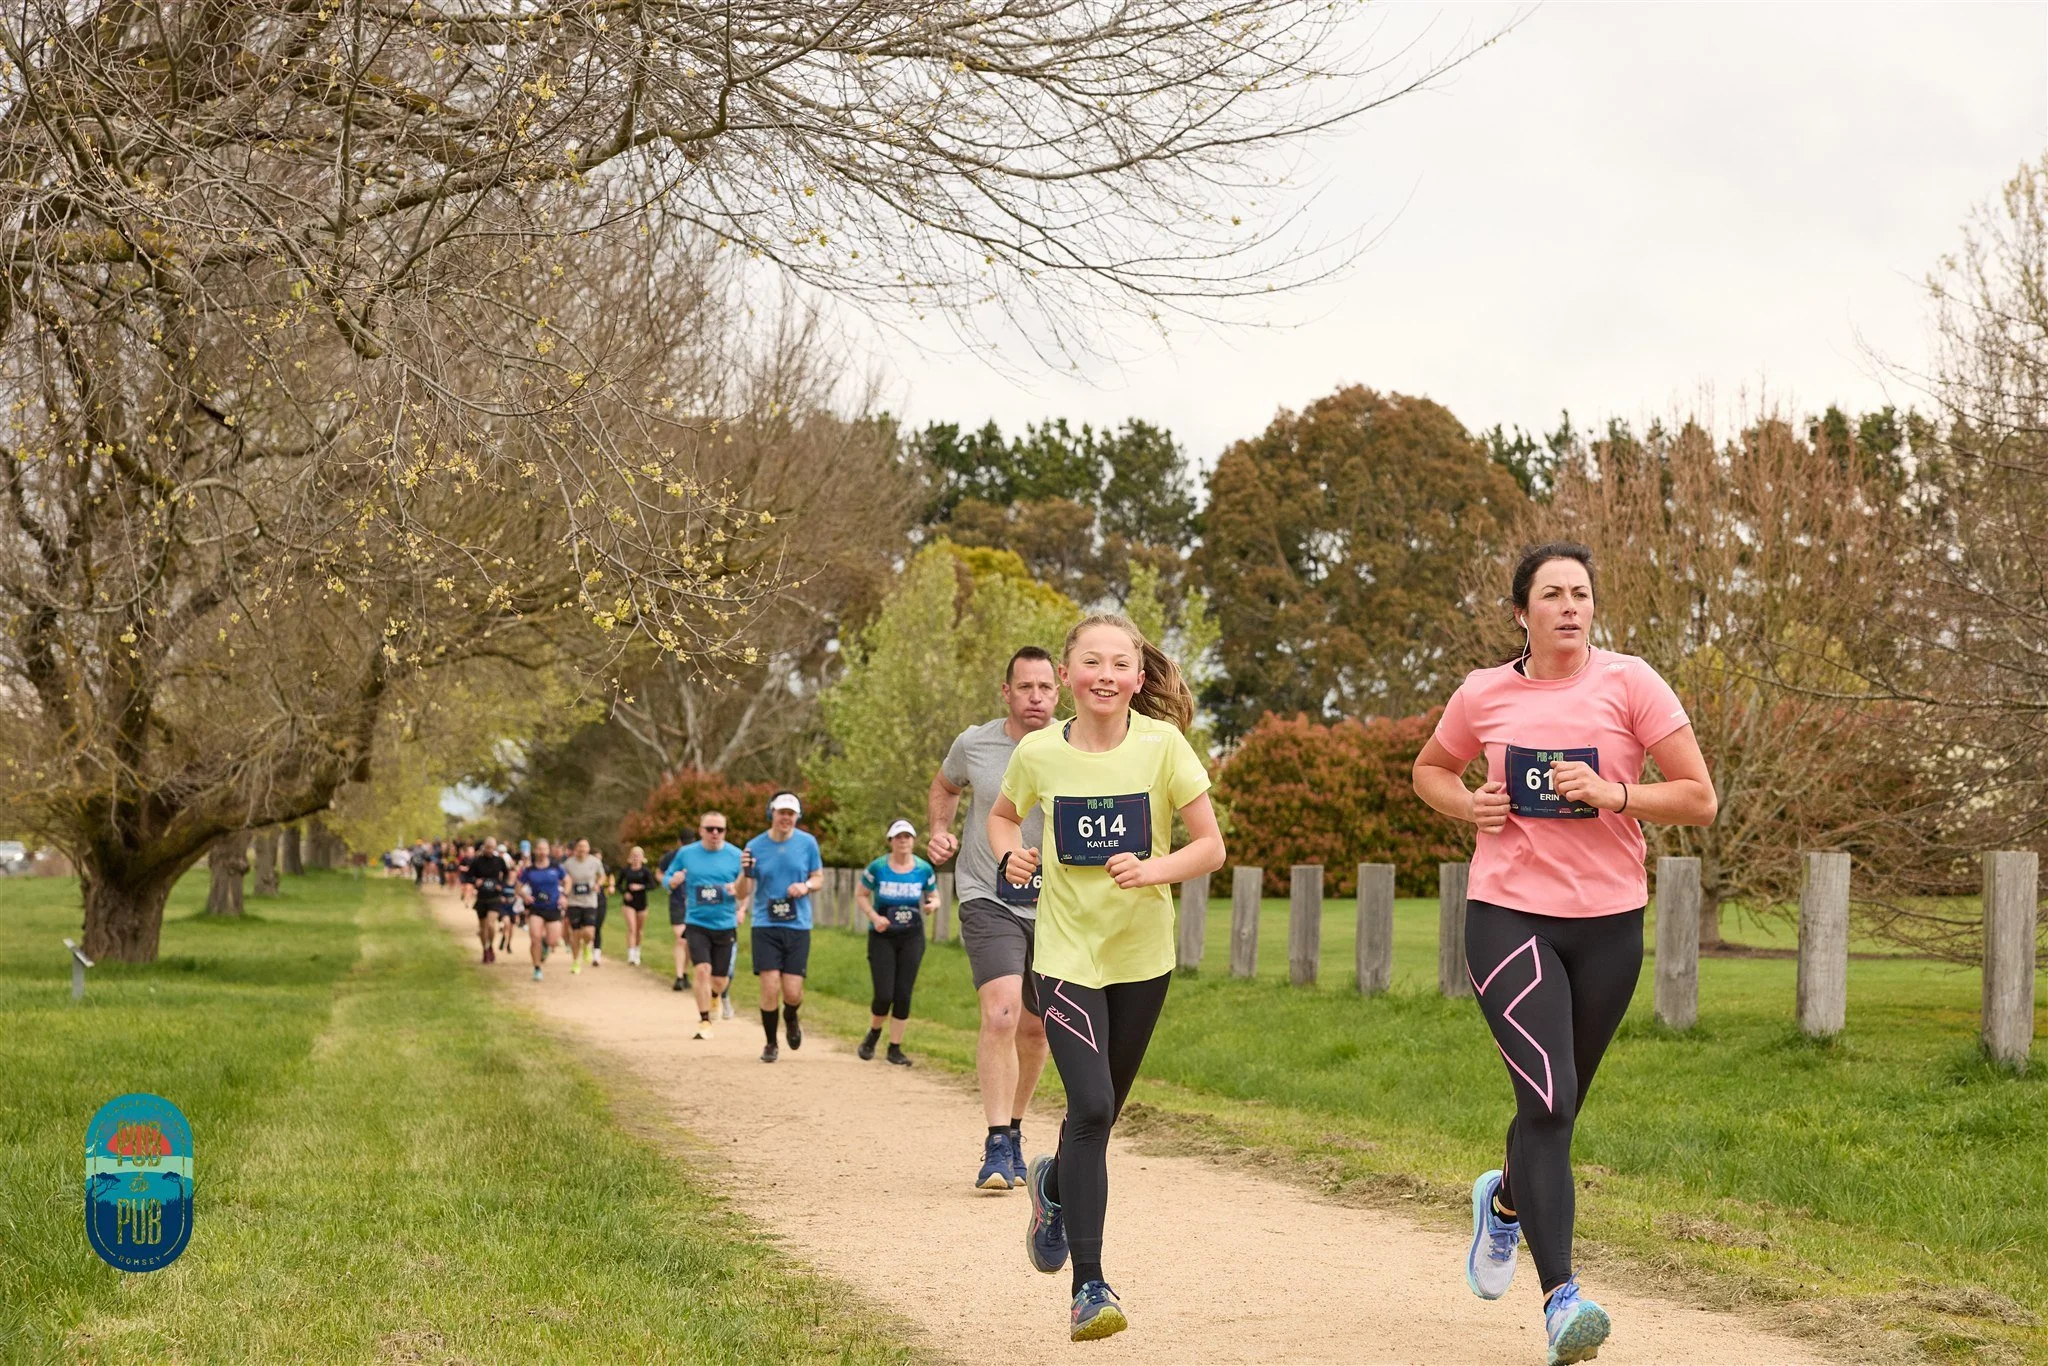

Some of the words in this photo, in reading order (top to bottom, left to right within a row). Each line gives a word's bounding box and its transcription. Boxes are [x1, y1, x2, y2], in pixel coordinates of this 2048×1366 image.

[1537, 752, 1548, 763] PUB
[1526, 767, 1554, 791] 61
[1540, 793, 1560, 801] ERIN
[1087, 799, 1098, 810] PUB
[1103, 798, 1114, 809] PUB
[1077, 814, 1127, 838] 614
[1086, 839, 1120, 848] KAYLEE
[1048, 1005, 1072, 1022] 2XU
